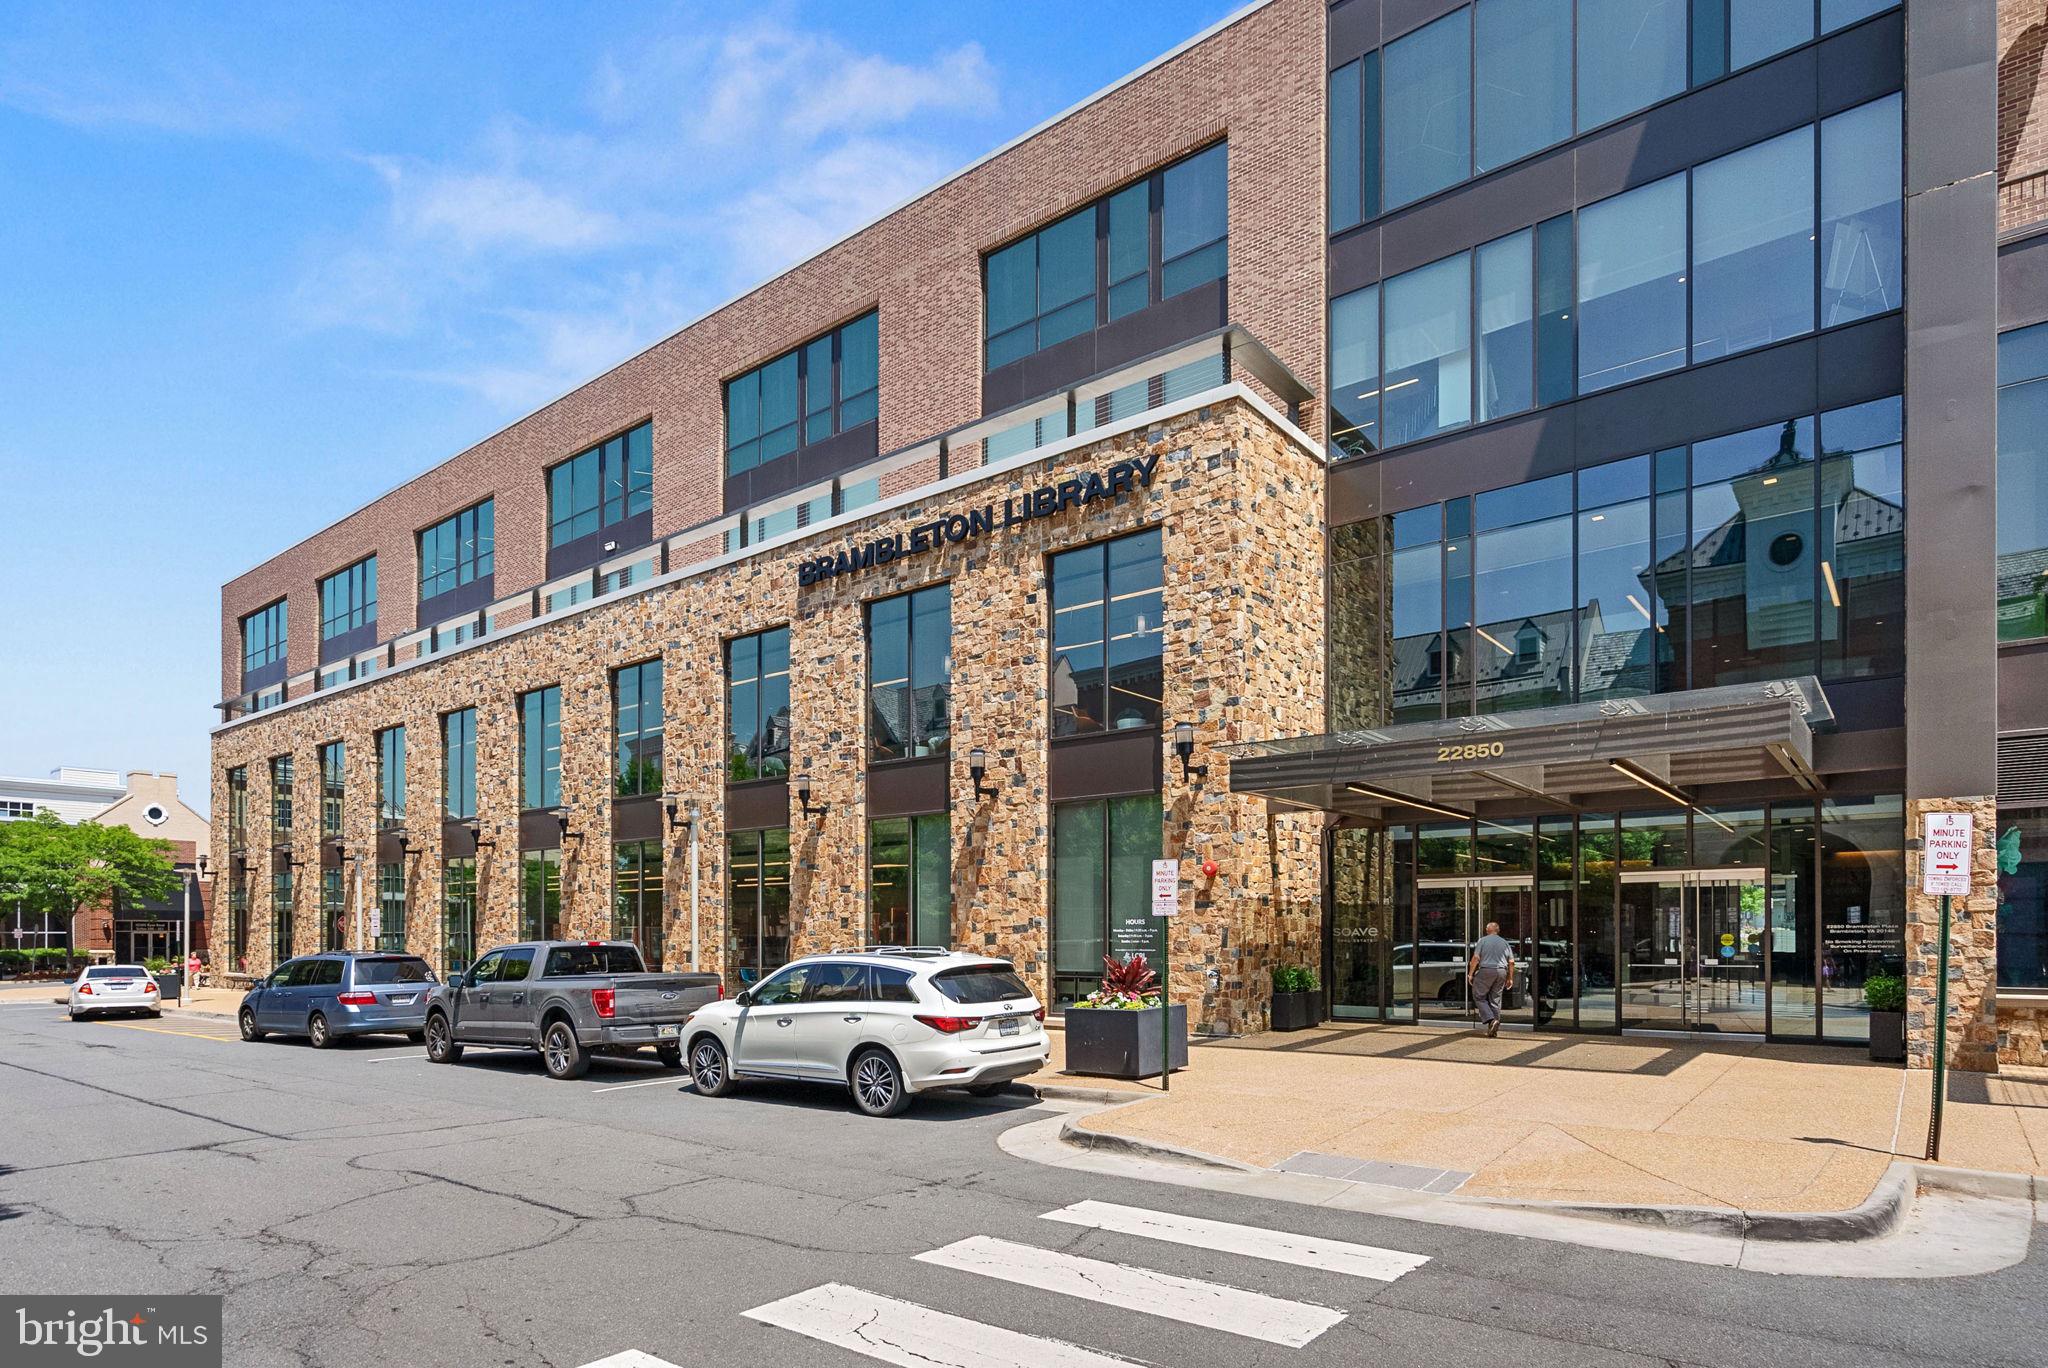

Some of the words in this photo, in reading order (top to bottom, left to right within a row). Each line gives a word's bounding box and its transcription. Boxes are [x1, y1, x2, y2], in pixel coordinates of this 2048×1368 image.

[799, 504, 994, 587] BRAMBLETON
[1004, 454, 1160, 527] LIBRARY
[1437, 741, 1504, 762] 22850
[1946, 817, 1954, 826] 15
[1932, 829, 1966, 837] MINUTE
[1929, 840, 1968, 849] PARKING
[1936, 851, 1960, 860] ONLY
